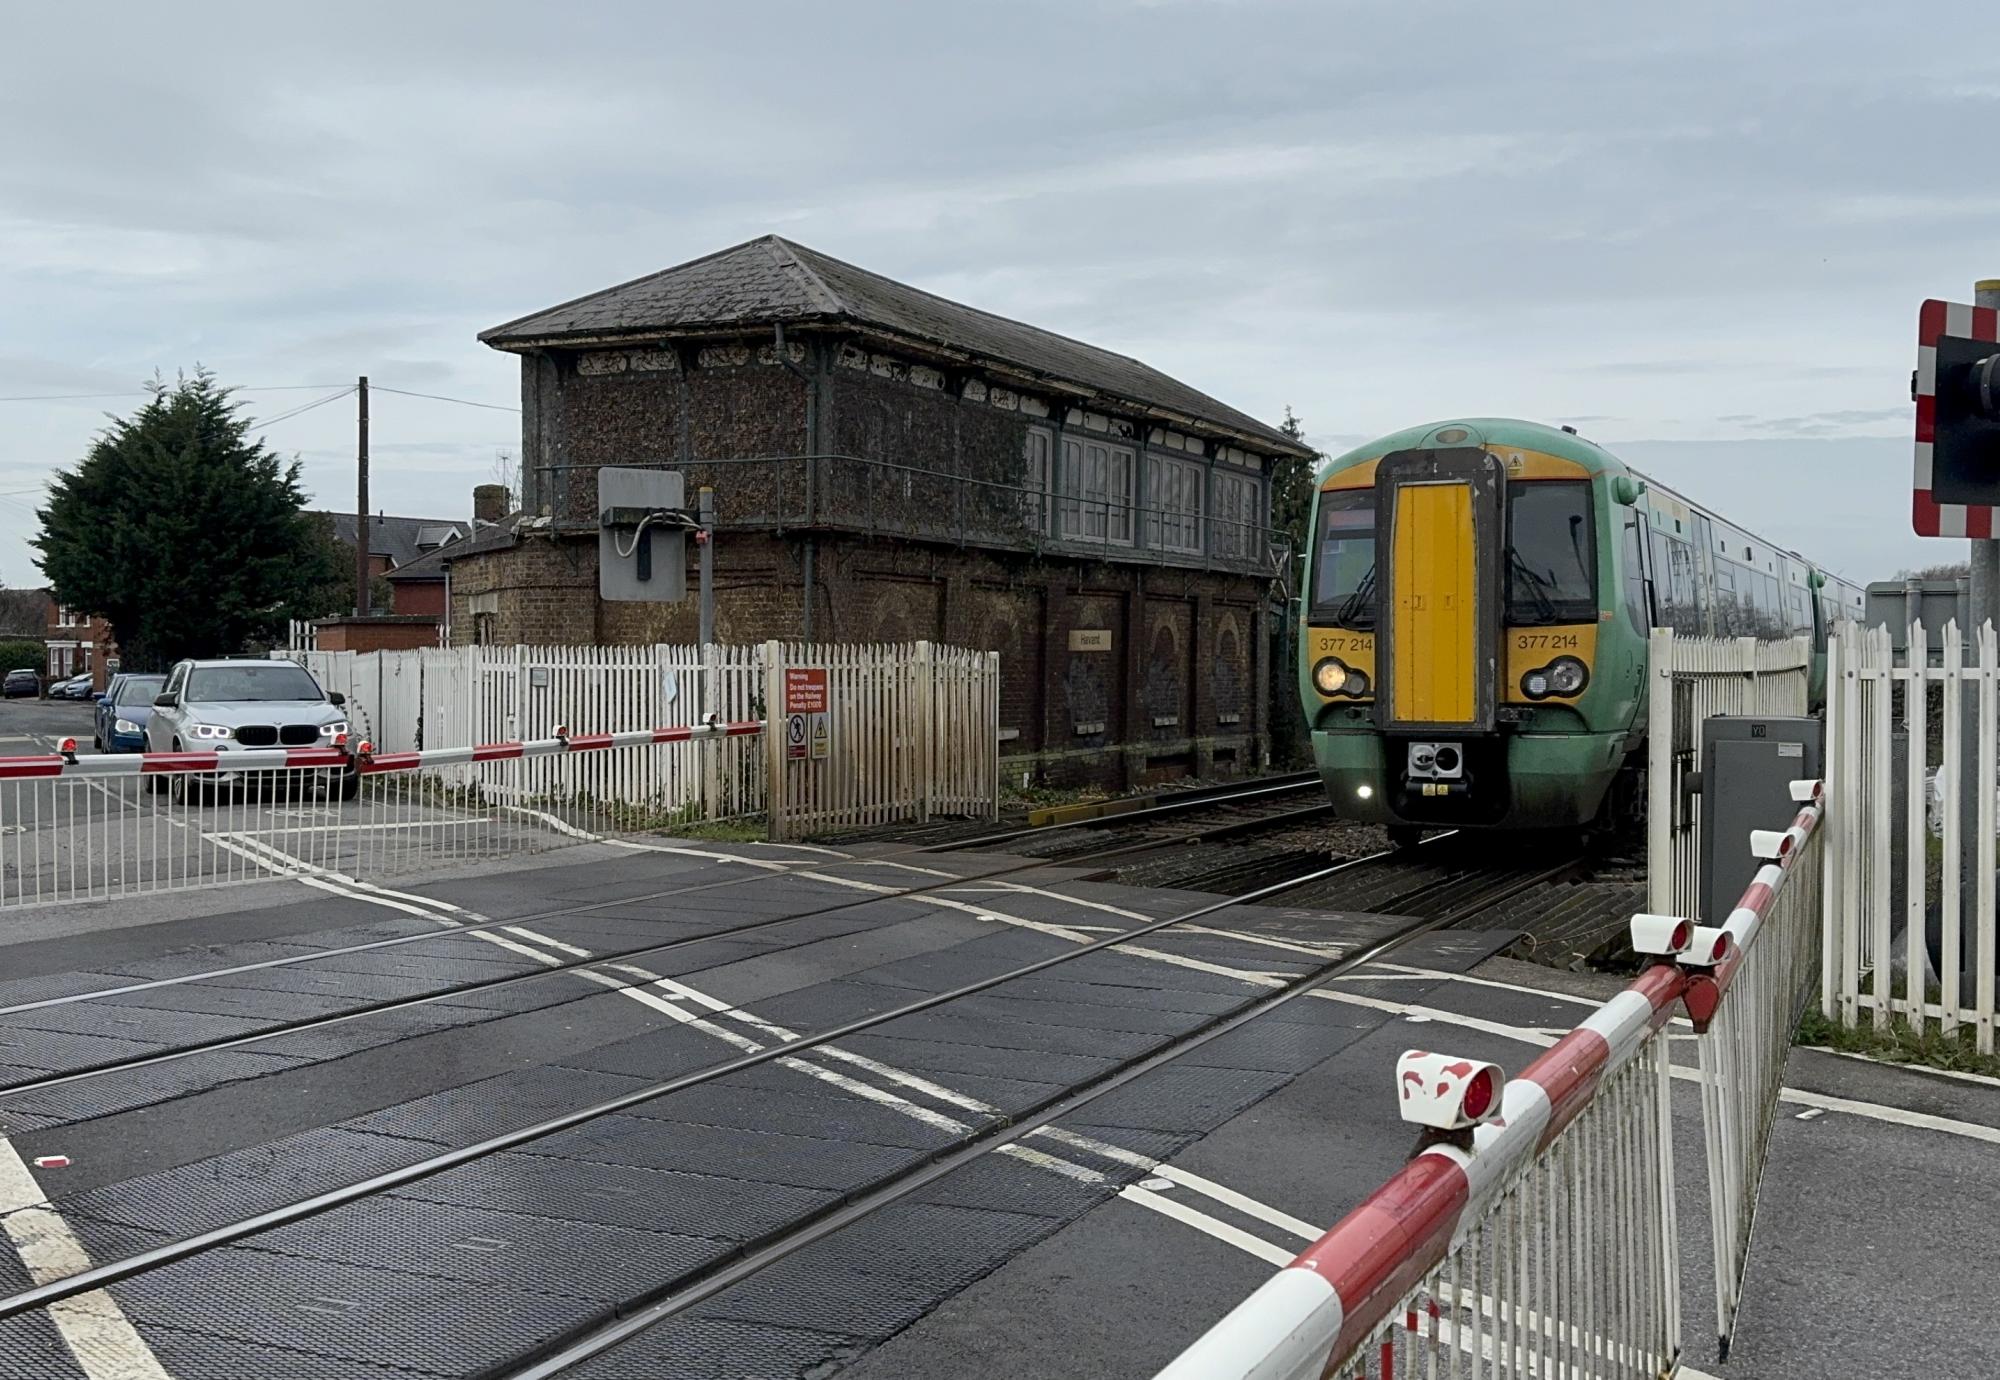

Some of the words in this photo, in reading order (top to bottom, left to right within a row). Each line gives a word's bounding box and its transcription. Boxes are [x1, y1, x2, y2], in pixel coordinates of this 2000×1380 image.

[1320, 638, 1346, 651] 377
[1350, 638, 1373, 651] 214
[1518, 635, 1549, 649] 377
[1551, 635, 1578, 649] 214
[789, 673, 808, 681] Warning
[805, 692, 821, 700] Railway
